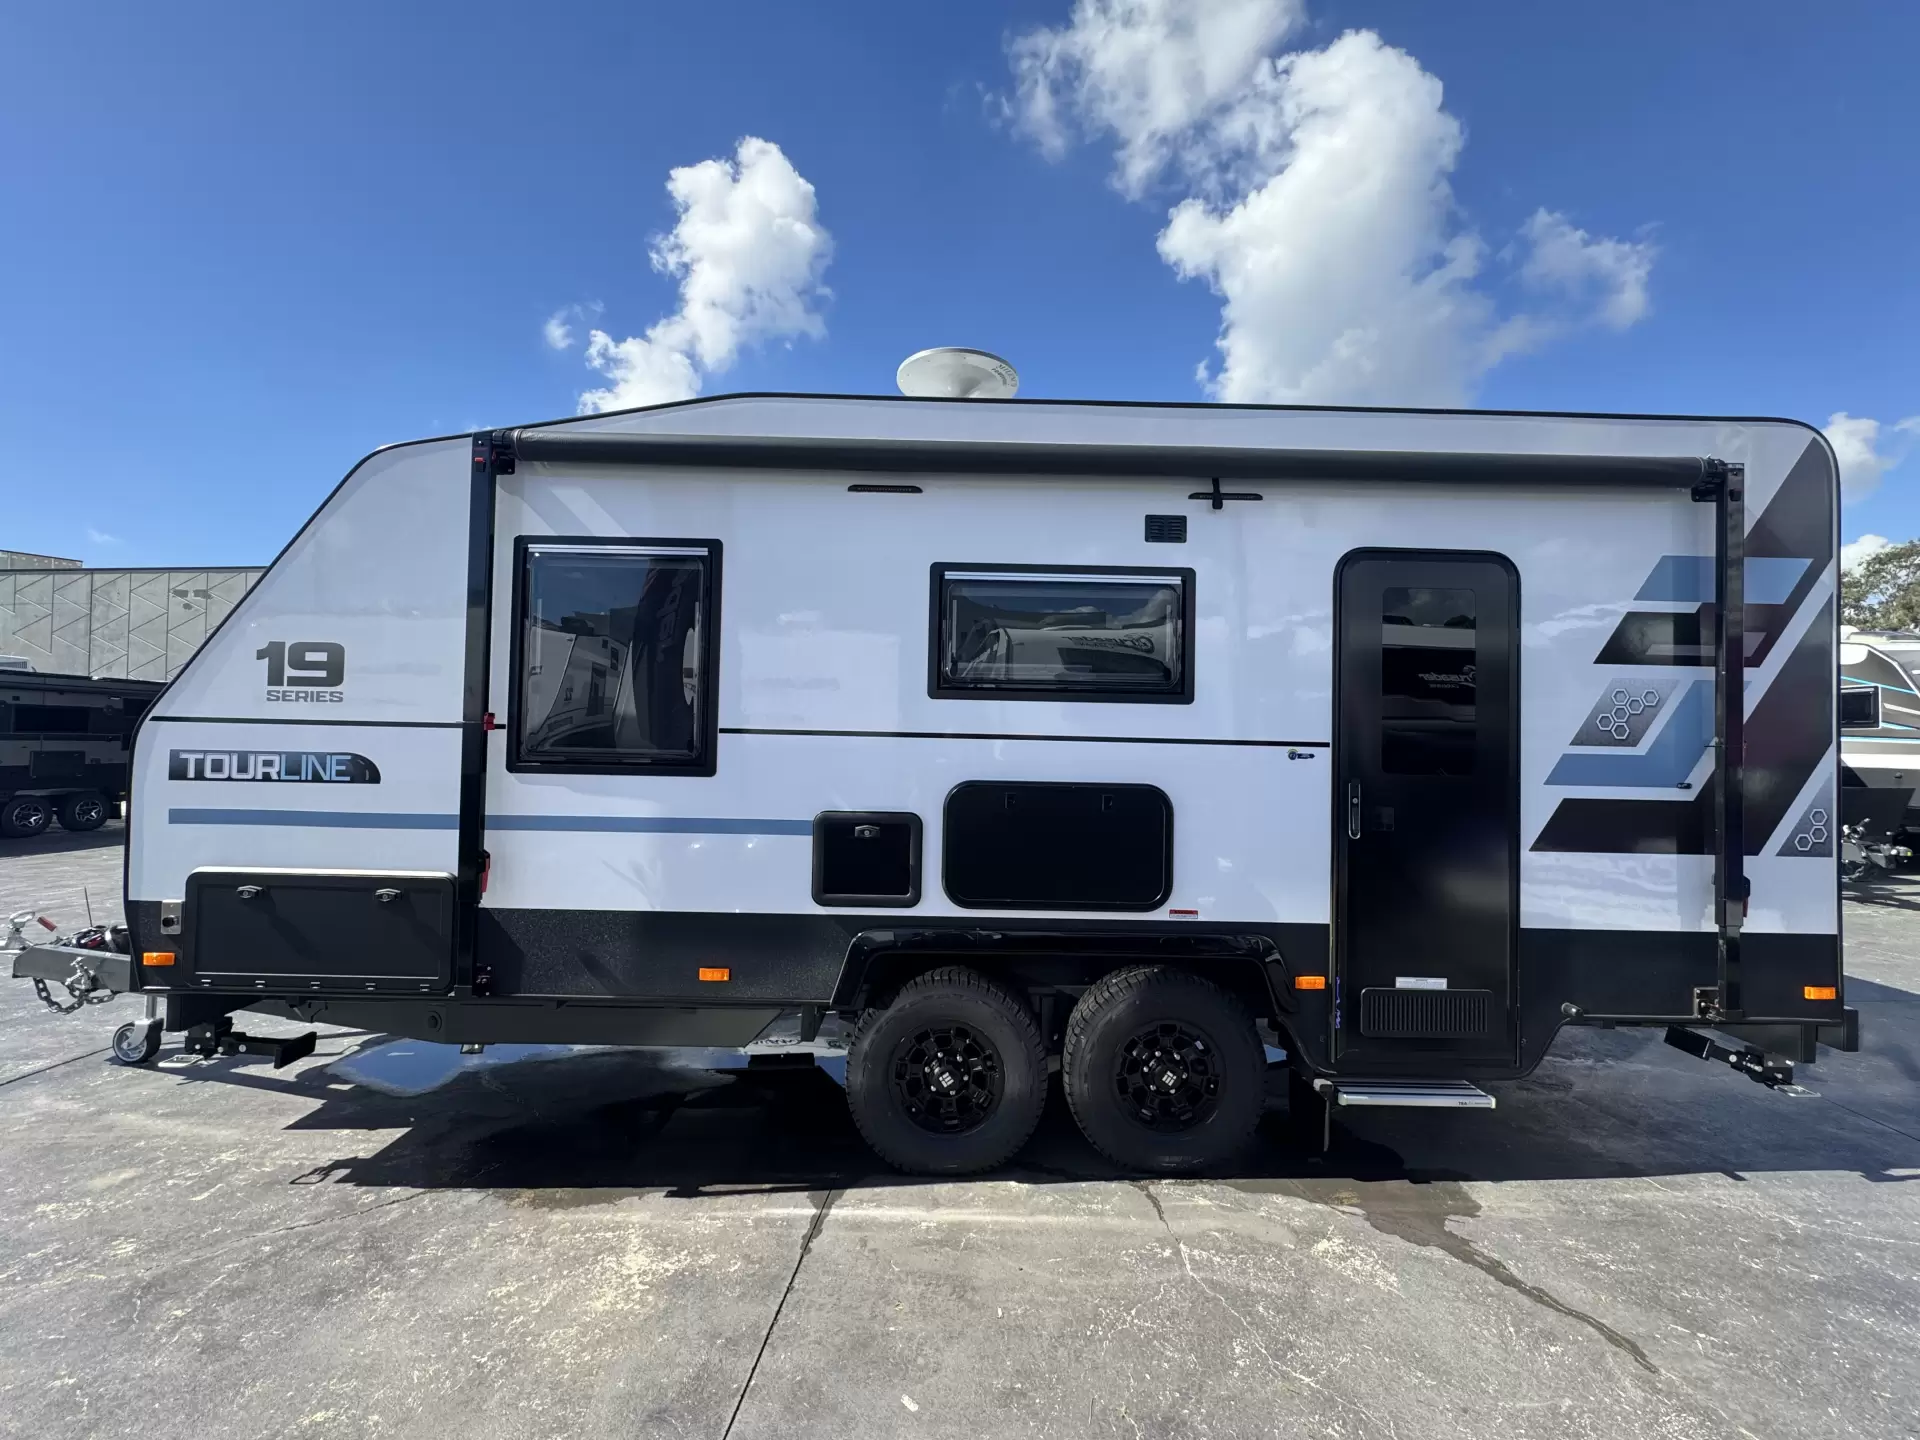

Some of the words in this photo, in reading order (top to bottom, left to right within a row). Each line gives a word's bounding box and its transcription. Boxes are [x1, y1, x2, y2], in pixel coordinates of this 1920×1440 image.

[256, 641, 345, 687] 19
[266, 690, 344, 702] SERIES
[179, 752, 351, 781] TOURLINE
